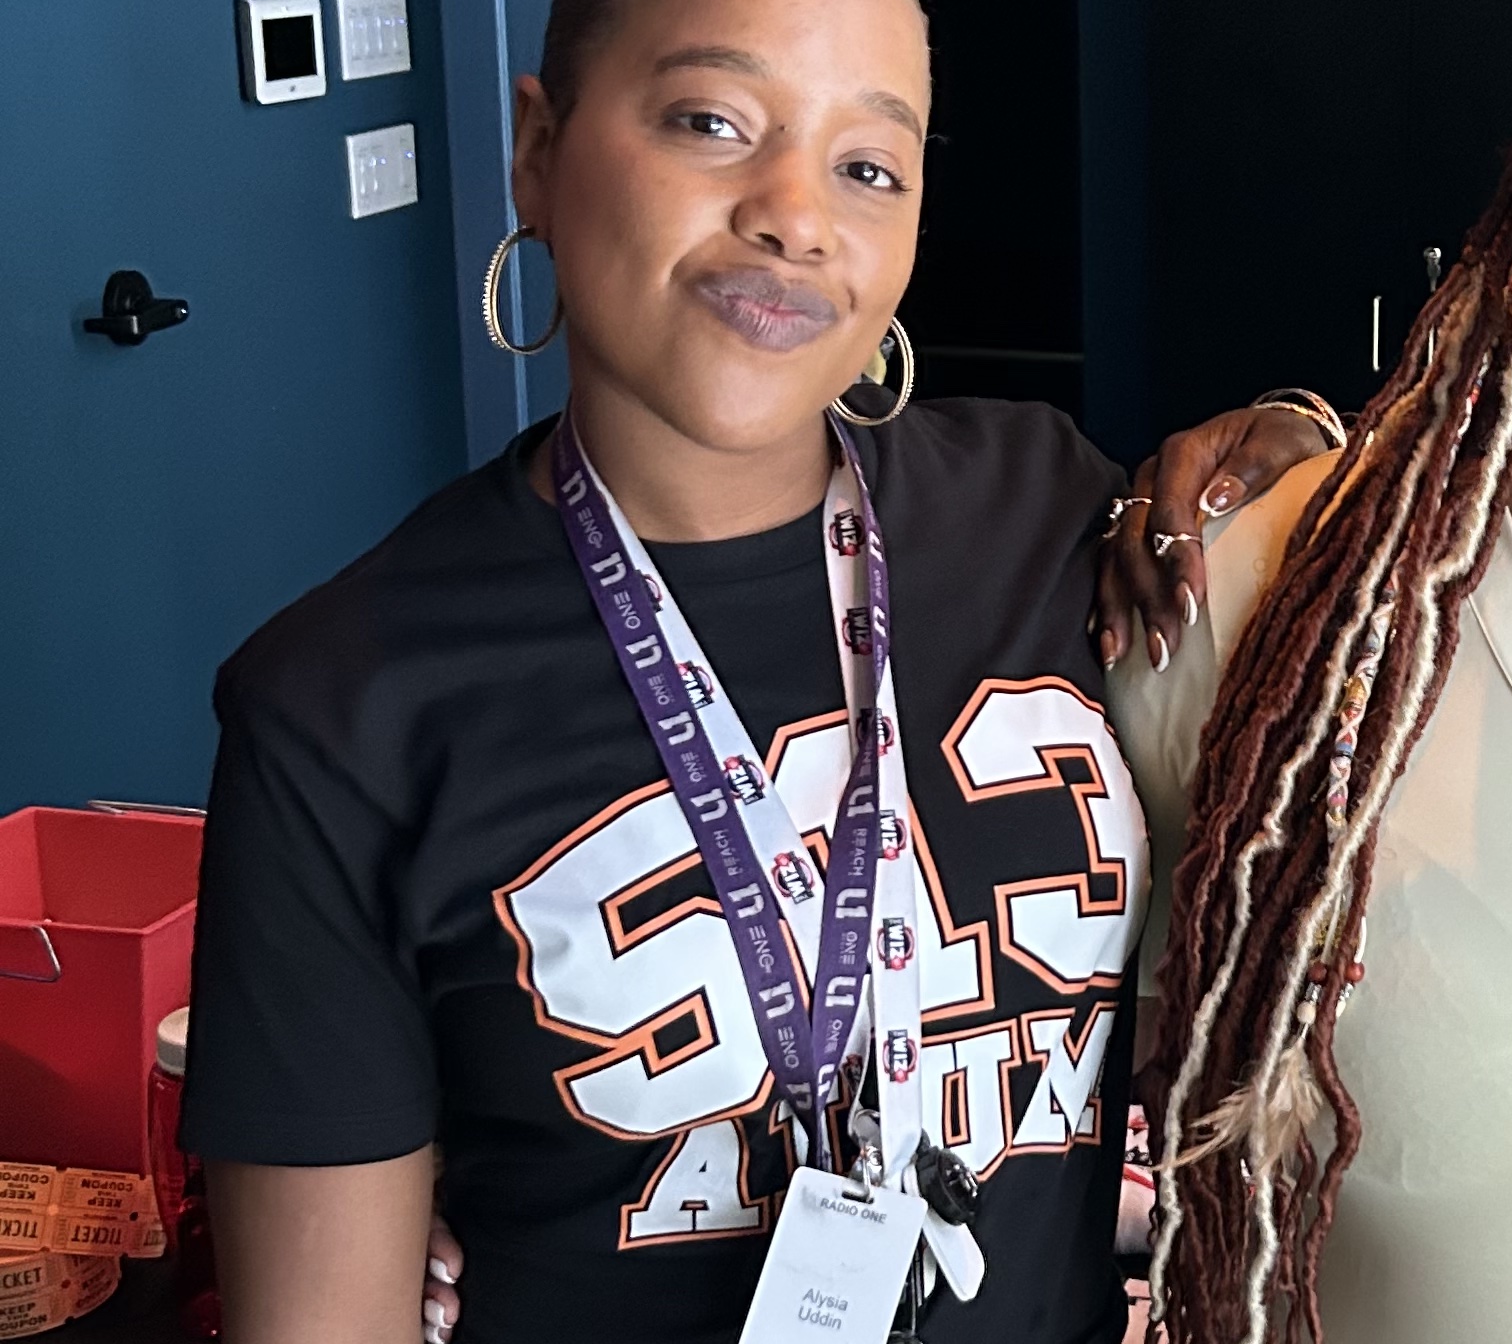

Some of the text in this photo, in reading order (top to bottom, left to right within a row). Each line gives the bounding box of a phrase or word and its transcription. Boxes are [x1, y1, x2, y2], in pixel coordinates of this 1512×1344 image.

[617, 999, 1116, 1251] AUM
[0, 1171, 50, 1185] COUPO
[81, 1178, 133, 1192] COUPON
[87, 1197, 123, 1208] KEEP
[820, 1197, 888, 1224] RADIO ONE
[0, 1219, 39, 1239] TICK
[71, 1224, 123, 1246] TICKET
[2, 1266, 42, 1290] CKET
[802, 1288, 849, 1312] Alysia
[0, 1314, 48, 1331] OUPON
[798, 1306, 842, 1330] Uddin
